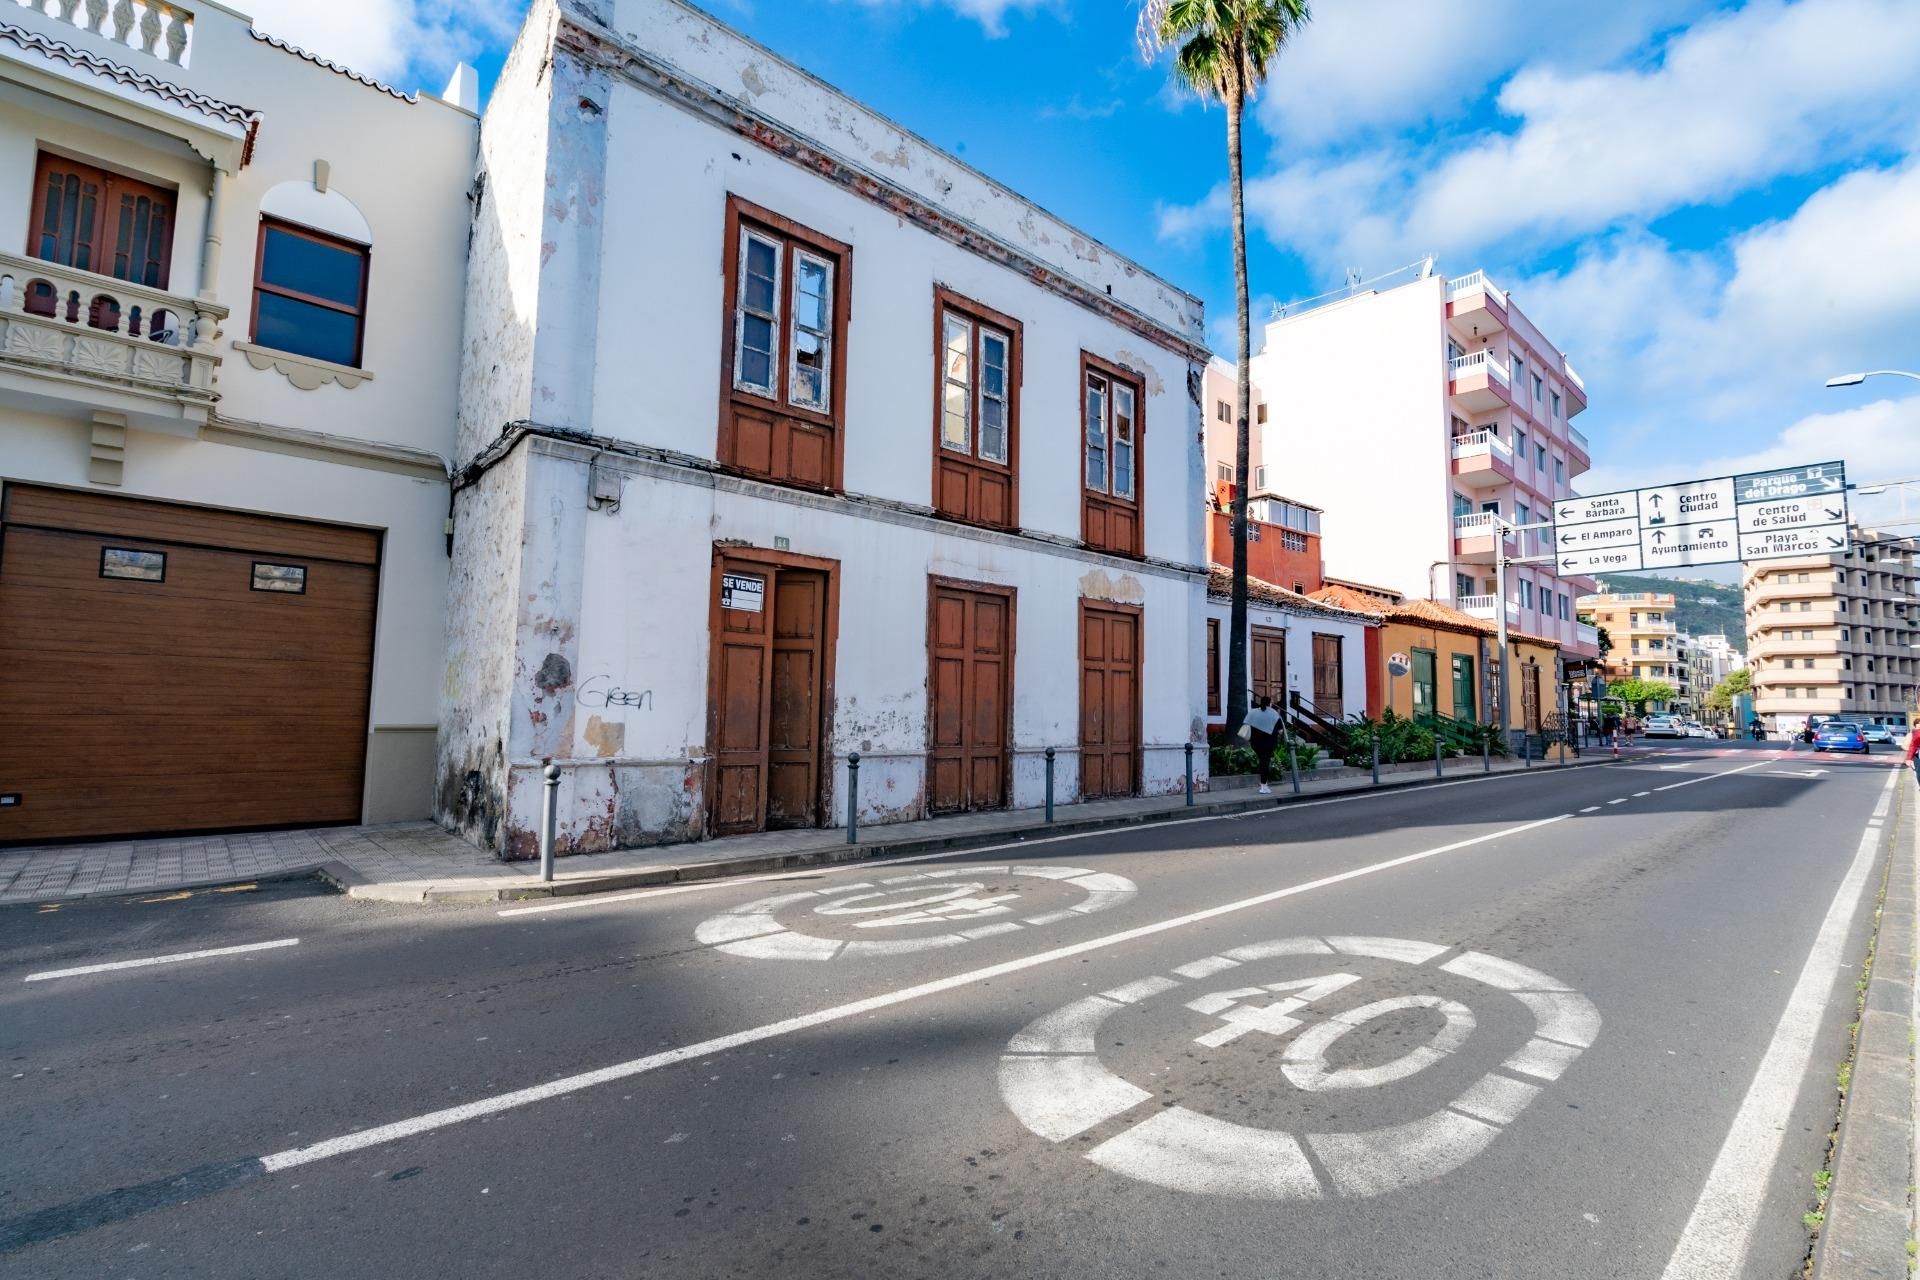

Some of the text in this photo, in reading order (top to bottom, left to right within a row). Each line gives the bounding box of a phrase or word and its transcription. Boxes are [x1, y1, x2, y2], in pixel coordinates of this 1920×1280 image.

[1752, 474, 1797, 488] Parque
[1744, 483, 1807, 499] del Drago
[1590, 498, 1619, 509] Santa
[1680, 492, 1717, 504] Centro
[1680, 501, 1719, 513] Ciudad
[1758, 504, 1800, 516] Centro
[1752, 512, 1807, 527] de Salud
[1581, 528, 1633, 541] El Amparo
[1765, 533, 1799, 544] Playa
[1651, 540, 1729, 556] Ayuntamiento
[1746, 541, 1819, 555] San Marcos
[1589, 554, 1628, 565] La Vega
[722, 577, 762, 593] SE VENDE
[1184, 972, 1478, 1092] 40
